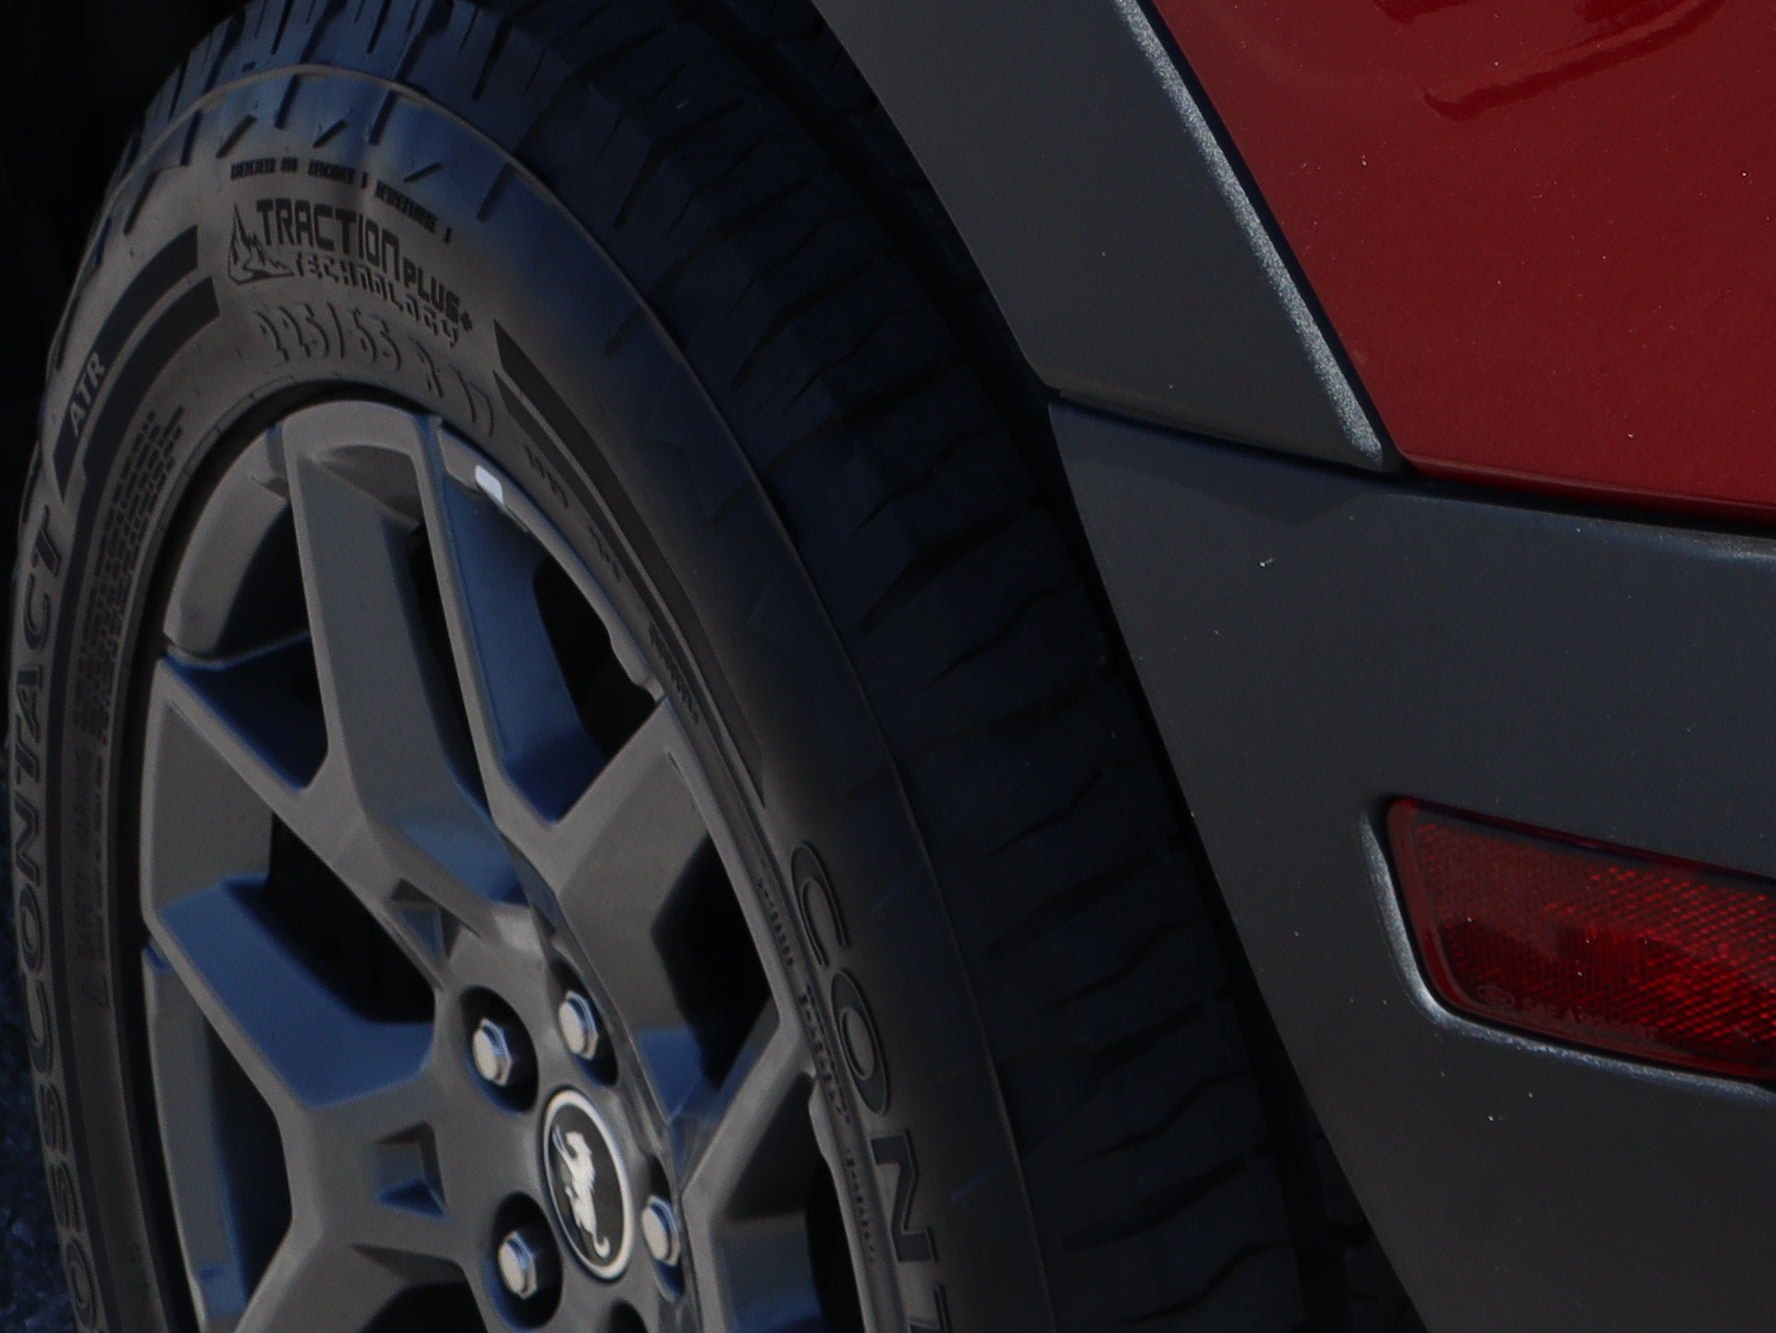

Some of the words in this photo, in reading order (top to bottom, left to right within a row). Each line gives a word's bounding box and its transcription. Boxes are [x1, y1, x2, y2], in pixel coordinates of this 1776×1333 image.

[256, 197, 401, 283] TRACTION
[253, 300, 403, 374] 225/65
[291, 250, 460, 350] TECHNOLOGY
[68, 350, 106, 437] ATR
